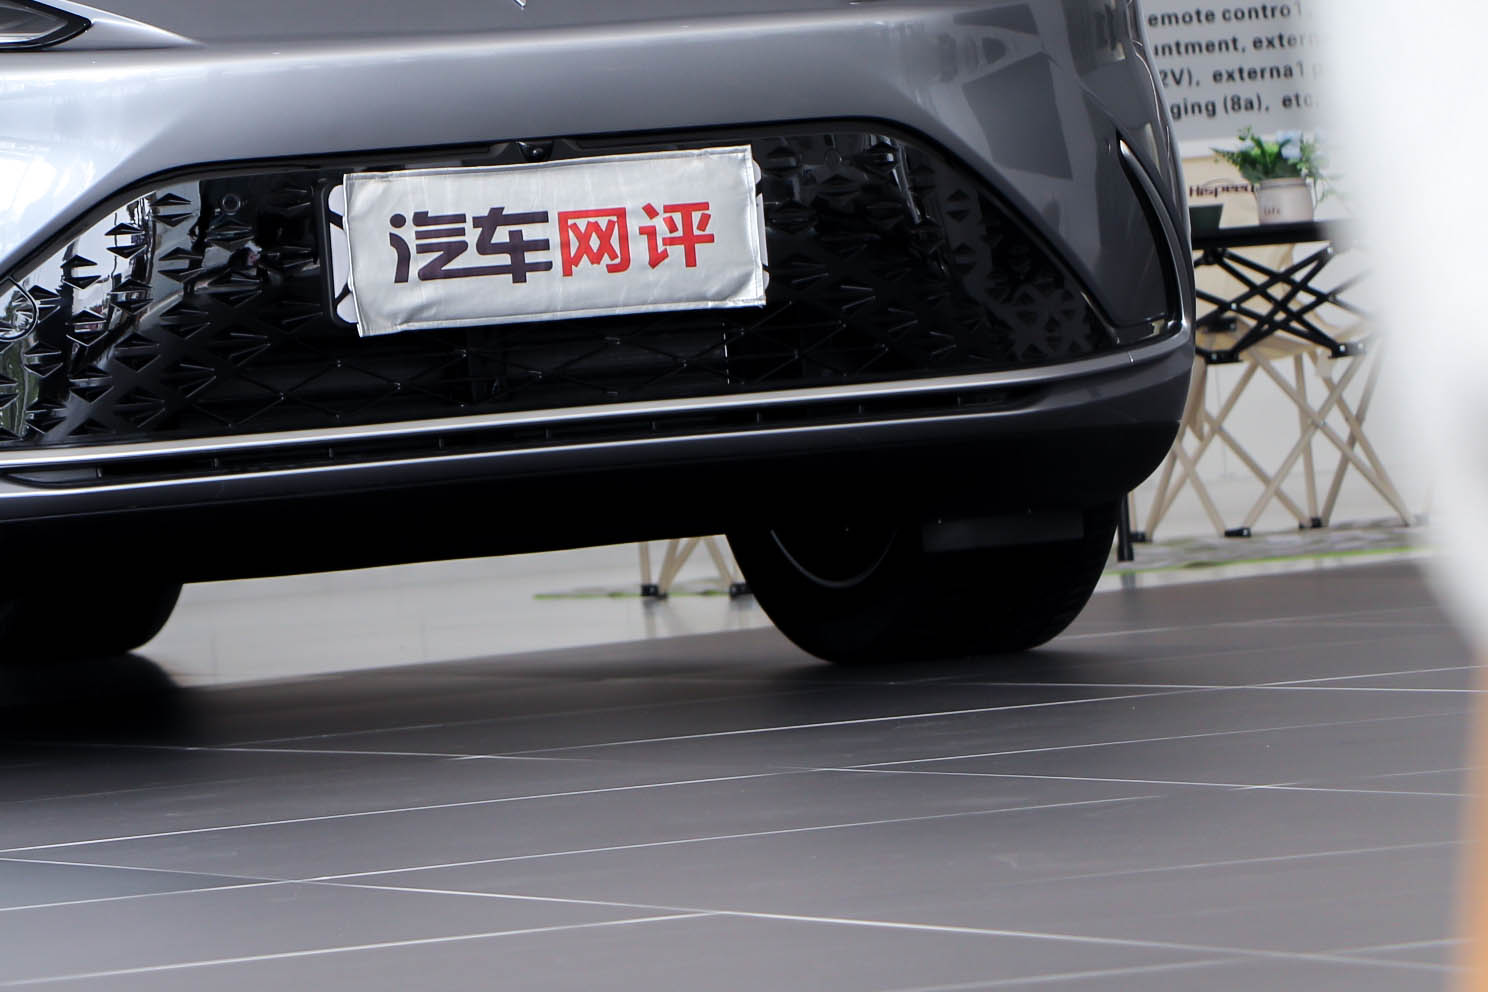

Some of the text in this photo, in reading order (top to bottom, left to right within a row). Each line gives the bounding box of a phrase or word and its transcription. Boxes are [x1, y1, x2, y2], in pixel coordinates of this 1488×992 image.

[1148, 8, 1215, 27] emote
[1170, 97, 1216, 120] ging
[389, 202, 715, 284] 汽车网评
